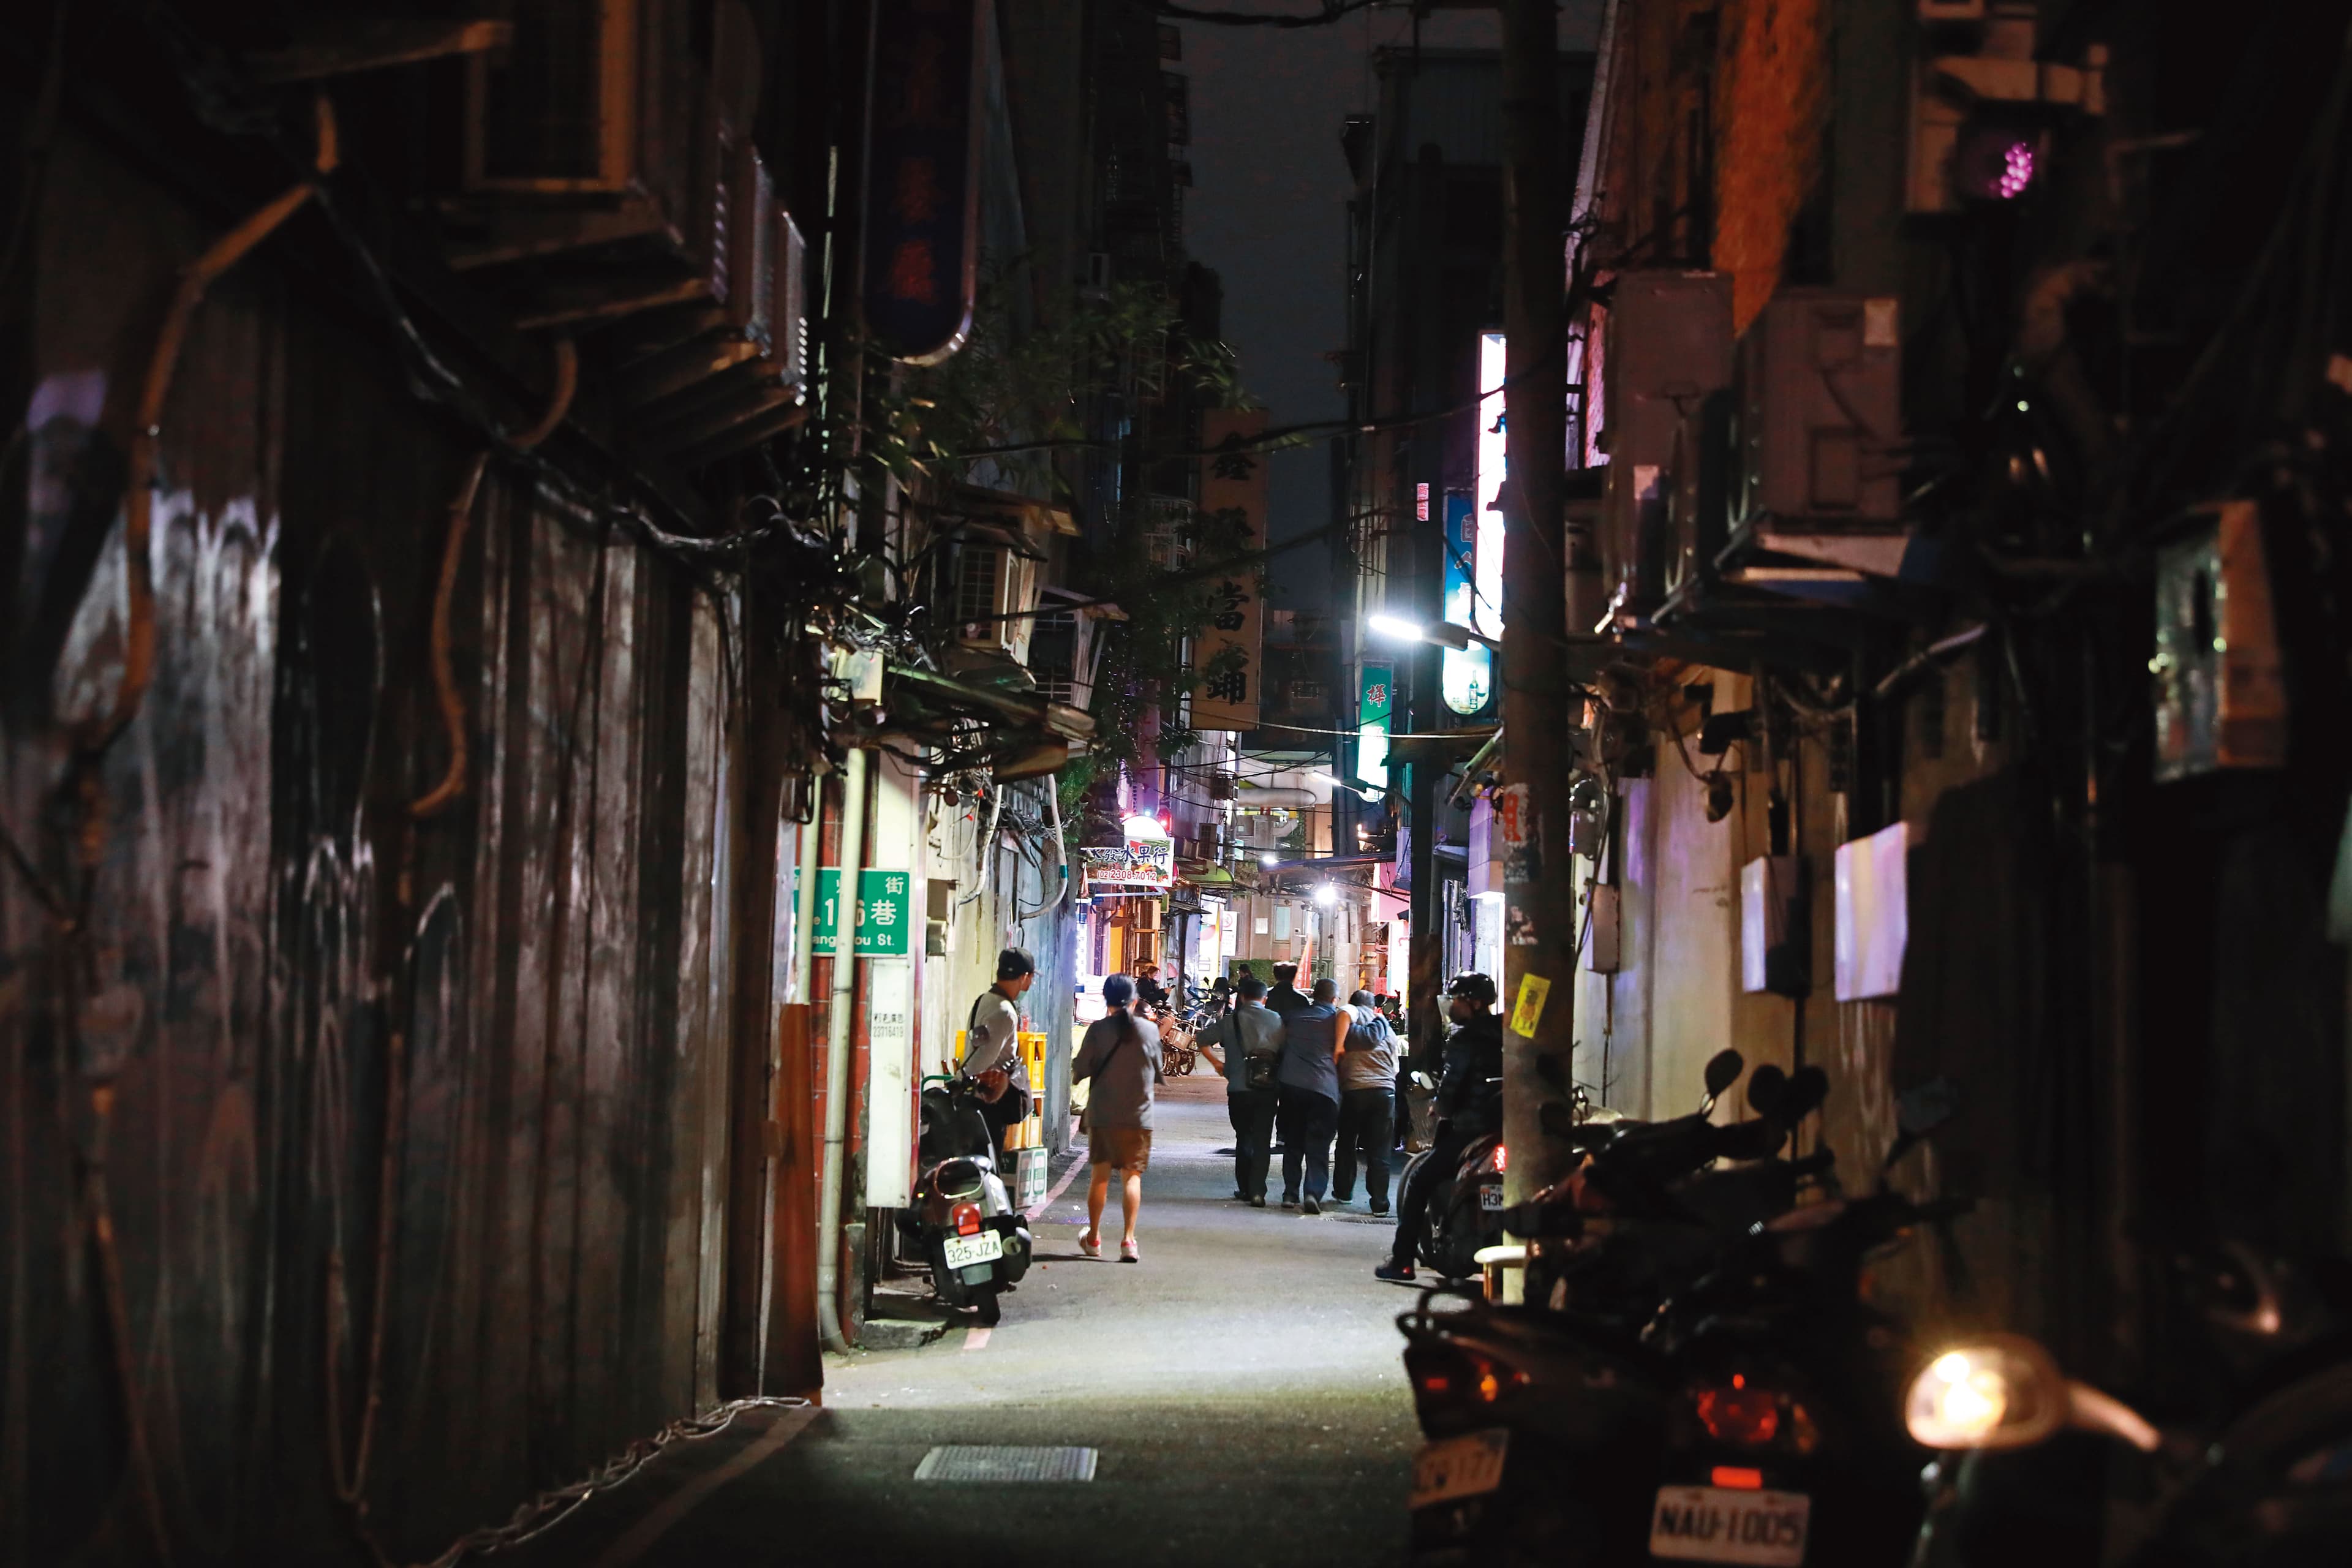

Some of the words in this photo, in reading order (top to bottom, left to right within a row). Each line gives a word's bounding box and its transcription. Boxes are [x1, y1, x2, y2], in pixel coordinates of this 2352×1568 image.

[1098, 870, 1156, 881] (02)2308-7012
[824, 898, 897, 926] 16巷
[877, 933, 895, 946] St.
[948, 1241, 999, 1263] 325-JZA
[1659, 1504, 1800, 1547] NAU-1005
